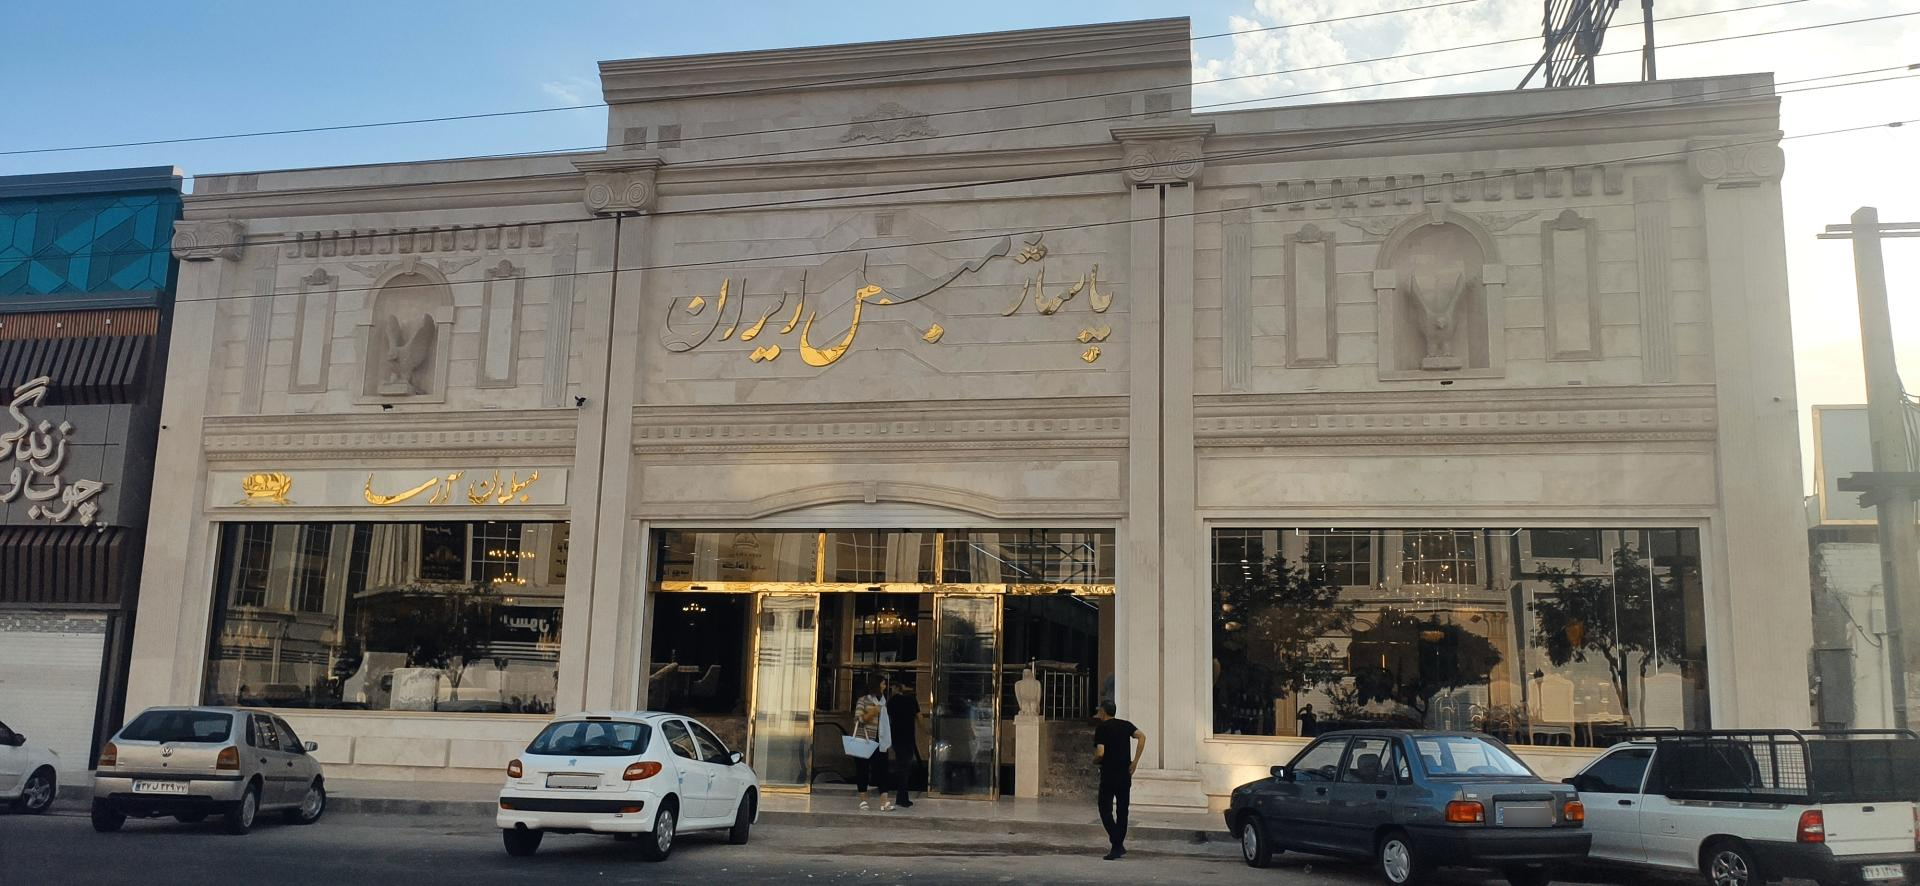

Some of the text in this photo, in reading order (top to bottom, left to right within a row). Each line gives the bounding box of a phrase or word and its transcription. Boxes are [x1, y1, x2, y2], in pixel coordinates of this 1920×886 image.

[659, 232, 1114, 367] پاساژ مبل ایران
[23, 470, 104, 527] چوب
[363, 469, 540, 505] مبلمان آرسا
